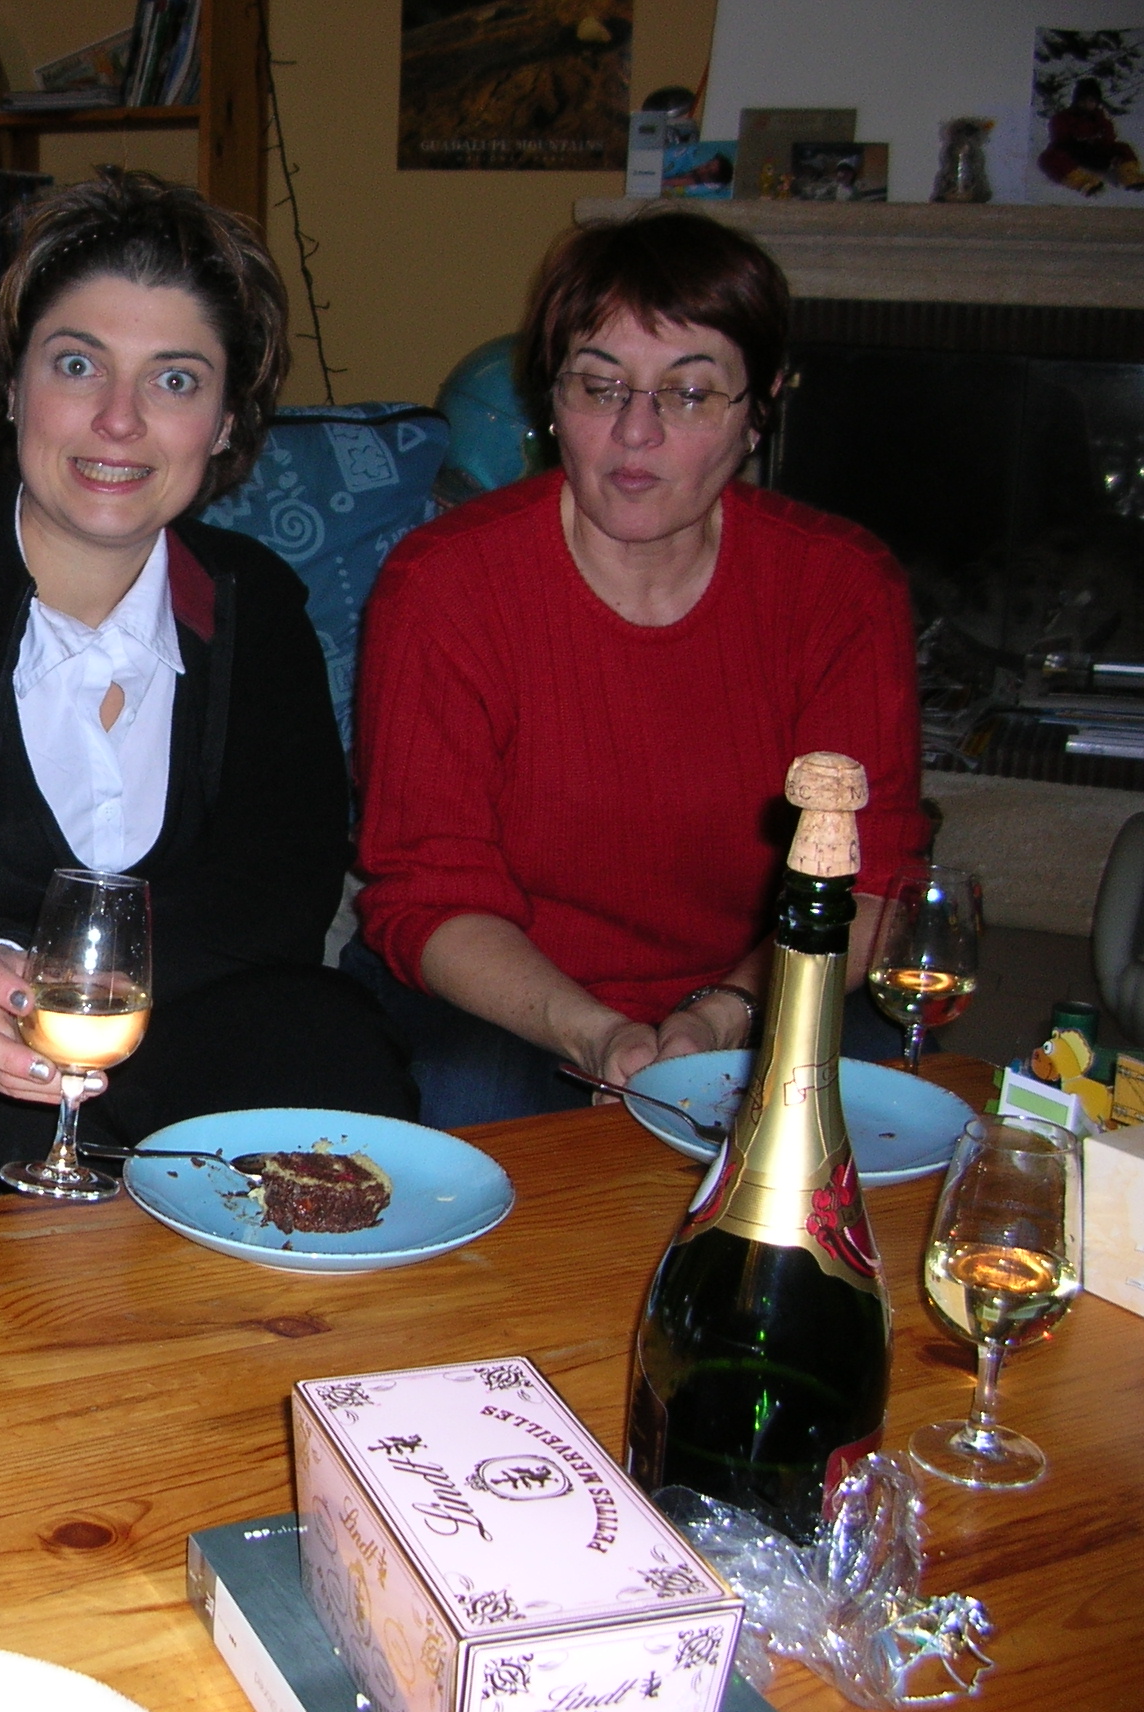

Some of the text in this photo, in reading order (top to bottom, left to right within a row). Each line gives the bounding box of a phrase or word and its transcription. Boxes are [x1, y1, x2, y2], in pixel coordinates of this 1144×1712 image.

[420, 140, 604, 151] GUADALUPE MOUNTAINS
[387, 1456, 493, 1543] Lindt
[480, 1405, 618, 1554] PETITES MERVEILLES
[339, 1494, 380, 1567] Lindt
[536, 1677, 639, 1712] Lindt
